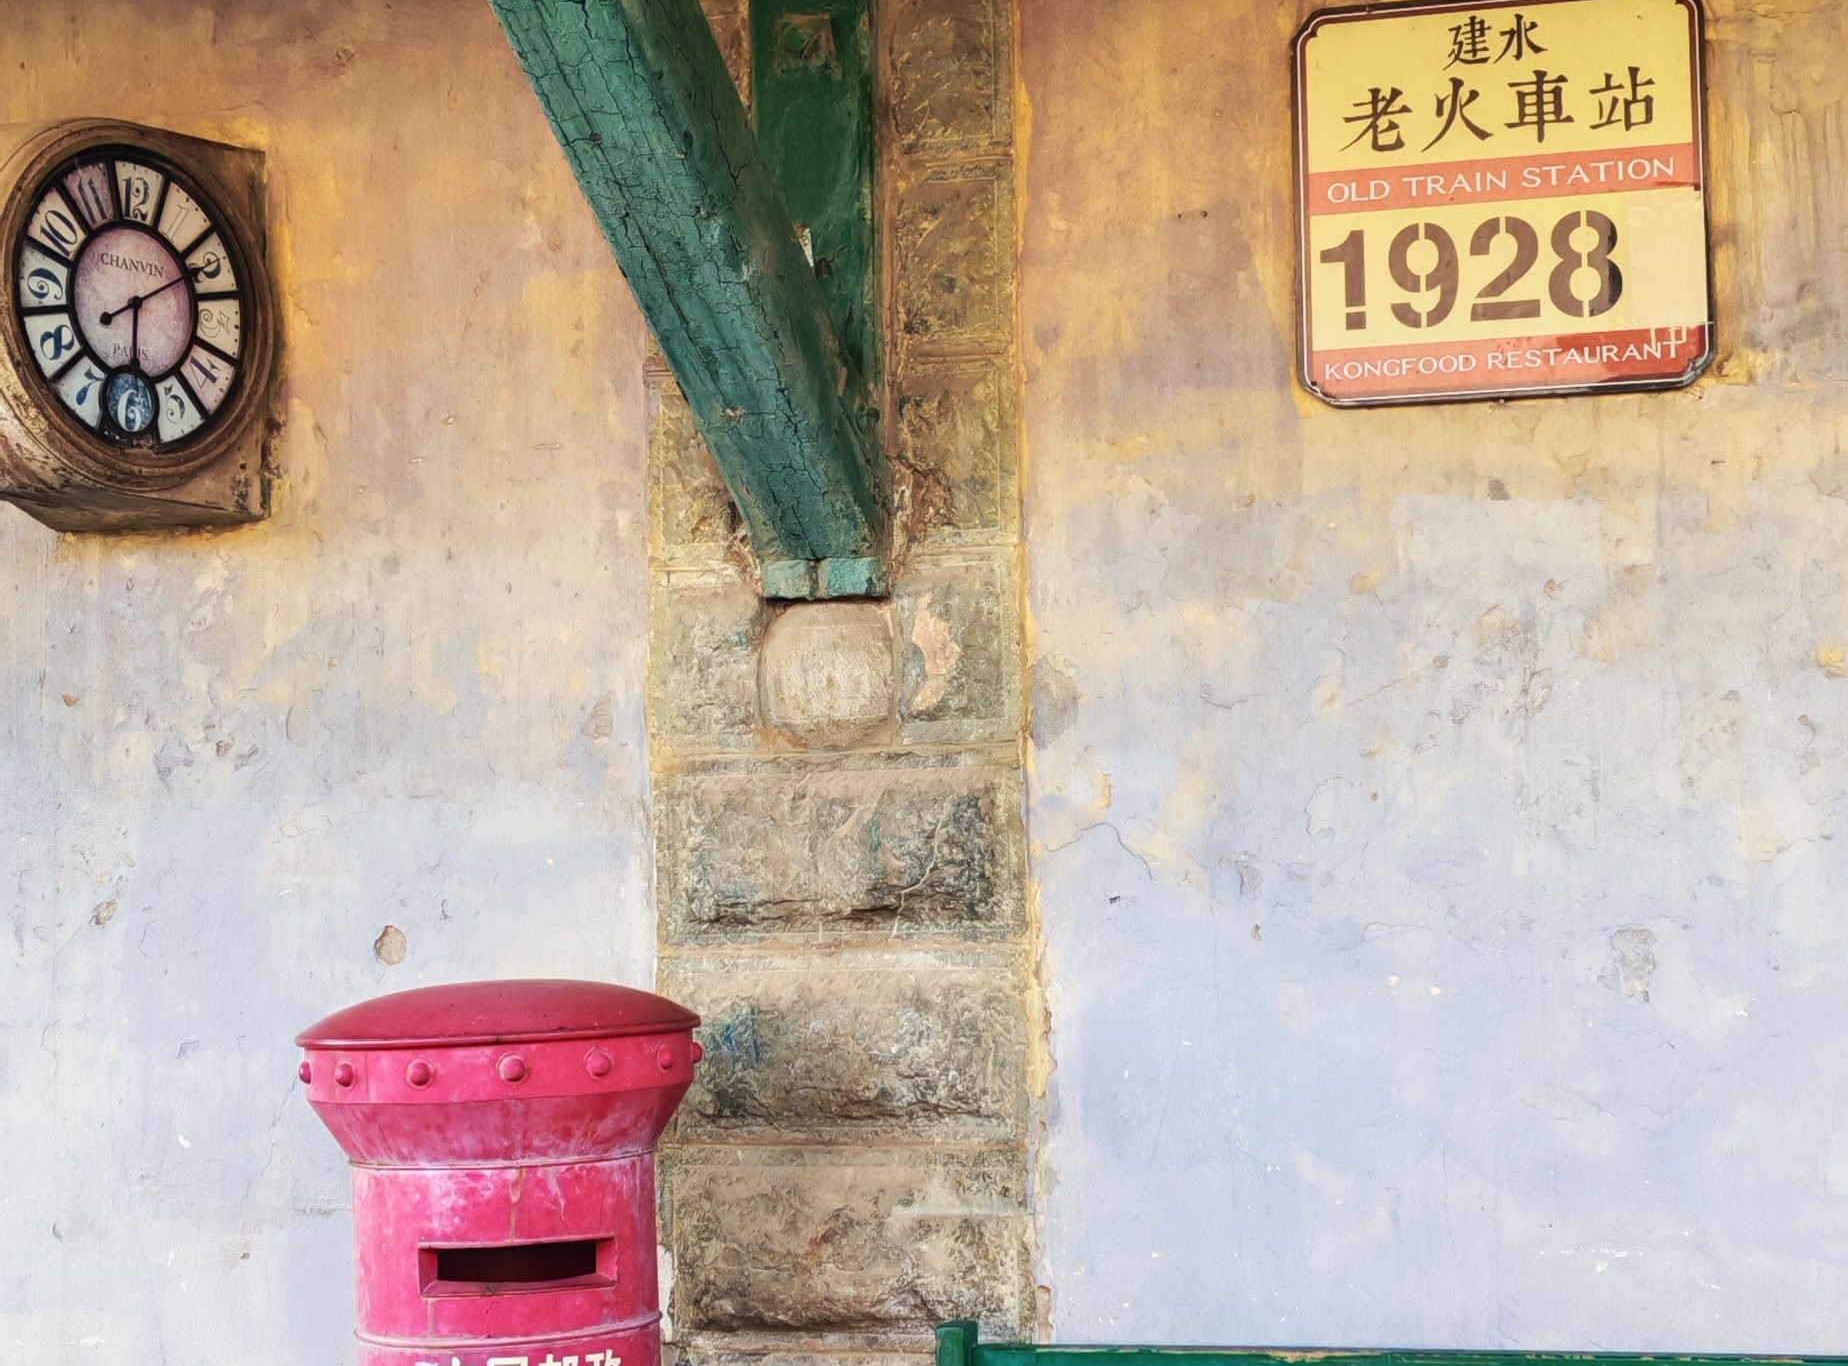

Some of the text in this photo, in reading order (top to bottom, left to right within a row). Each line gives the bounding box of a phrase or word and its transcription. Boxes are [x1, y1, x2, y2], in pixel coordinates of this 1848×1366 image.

[1443, 13, 1548, 71] 建水
[1340, 67, 1655, 153] 老火車站
[77, 176, 108, 226] 11
[122, 176, 149, 222] 12
[1327, 157, 1675, 204] OLD TRAIN STATION
[40, 209, 77, 257] 10
[161, 203, 190, 243] 1
[27, 267, 63, 300] 9
[100, 252, 164, 278] CHANVIN
[188, 251, 221, 284] 2
[1320, 210, 1623, 331] 1928
[39, 324, 75, 361] 8
[199, 308, 230, 339] 3
[112, 342, 149, 362] PAIS
[190, 354, 220, 390] 4
[1324, 340, 1684, 381] KONGFOOD RESTAURANT
[76, 366, 105, 406] 7
[163, 383, 186, 424] 5
[117, 388, 142, 432] 6
